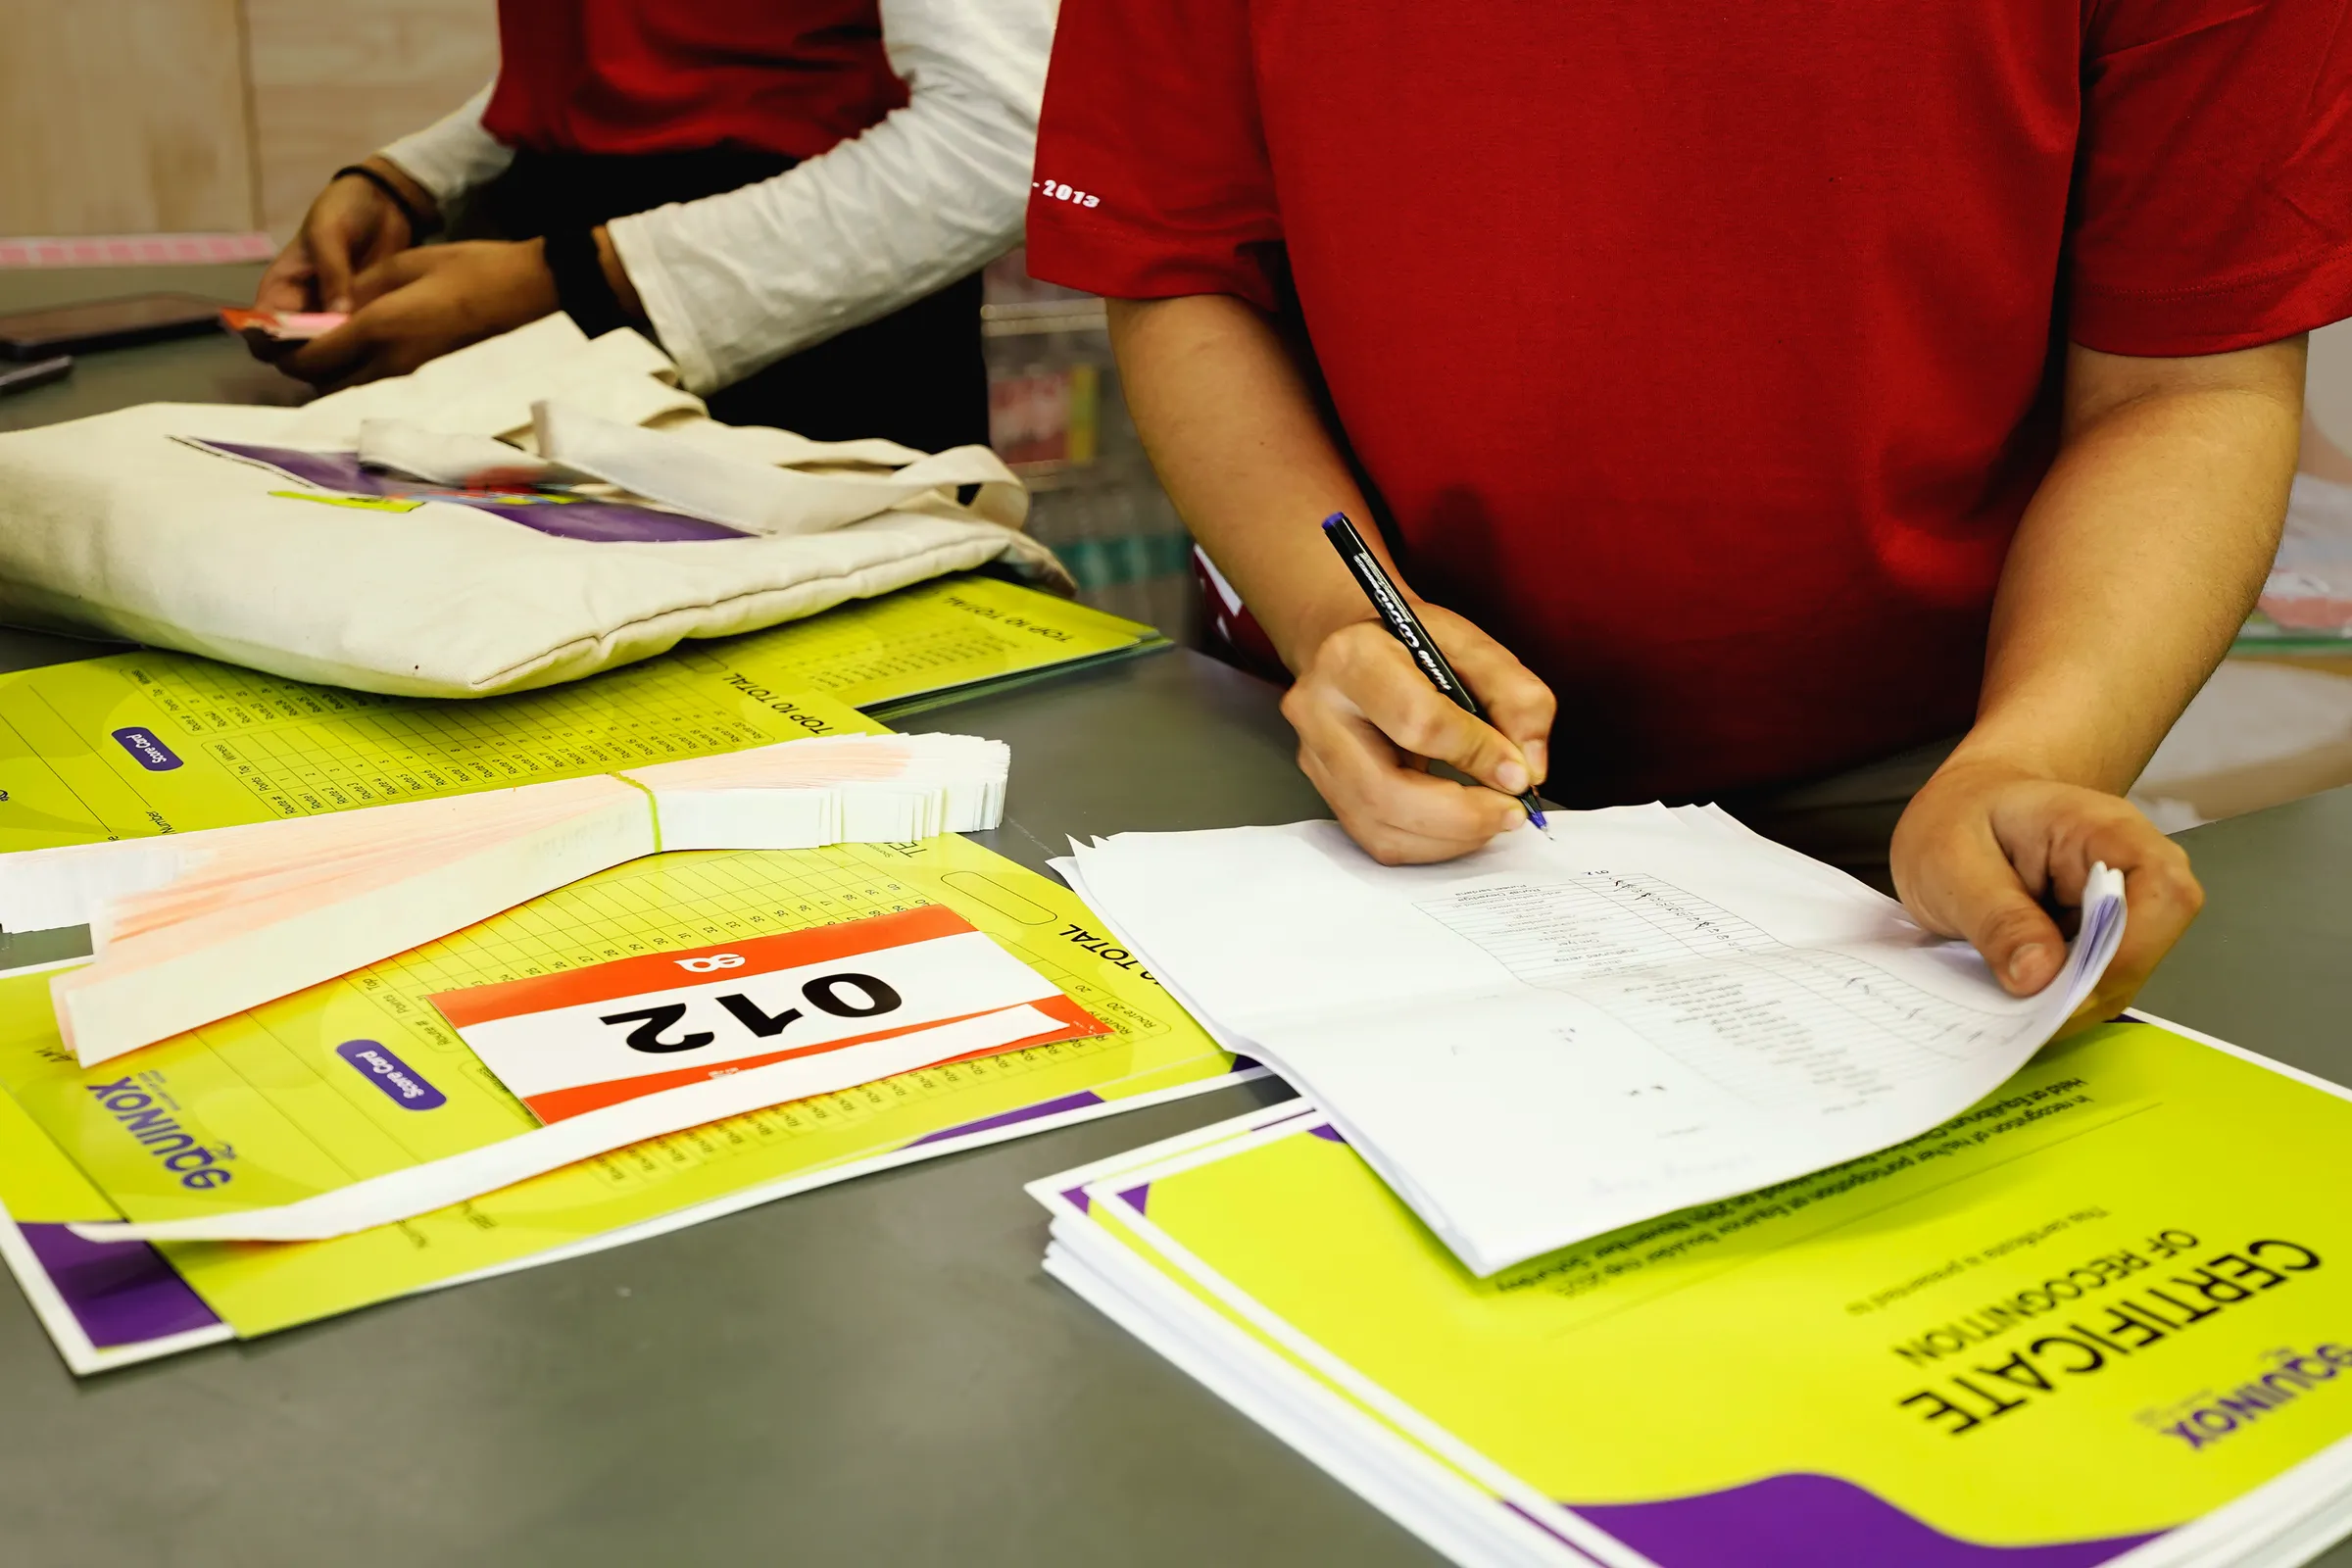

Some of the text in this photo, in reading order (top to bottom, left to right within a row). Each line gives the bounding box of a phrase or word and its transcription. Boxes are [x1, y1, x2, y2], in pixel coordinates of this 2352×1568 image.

[1042, 179, 1101, 208] 2013
[943, 596, 1005, 620] TOTAL
[1028, 626, 1073, 643] TOP
[722, 672, 833, 735] TOP 10 TOTAL
[125, 733, 168, 763] Score Card
[215, 743, 237, 762] Witness
[238, 764, 252, 775] Top
[452, 769, 470, 783] Route
[474, 764, 495, 779] Route
[251, 776, 271, 793] Points
[403, 777, 423, 791] Route
[428, 772, 447, 787] Route
[354, 786, 373, 801] Route
[379, 781, 399, 796] Route
[304, 795, 323, 810] Route
[329, 791, 349, 805] Route
[279, 801, 297, 815] Route
[887, 883, 902, 892] 40
[653, 937, 669, 946] 30
[1058, 923, 1139, 970] TOTAL
[603, 949, 619, 957] 28
[525, 967, 542, 976] 25
[552, 960, 568, 969] 26
[363, 978, 381, 991] Top
[383, 994, 411, 1014] Points
[1075, 984, 1157, 1030] Route 20 20
[599, 973, 903, 1054] 012
[1098, 1015, 1133, 1036] Route
[424, 1027, 452, 1047] Route
[354, 1050, 425, 1100] Score Card
[1891, 1228, 2199, 1368] OF RECOGNITION
[1897, 1238, 2322, 1436] CERTIFICATE
